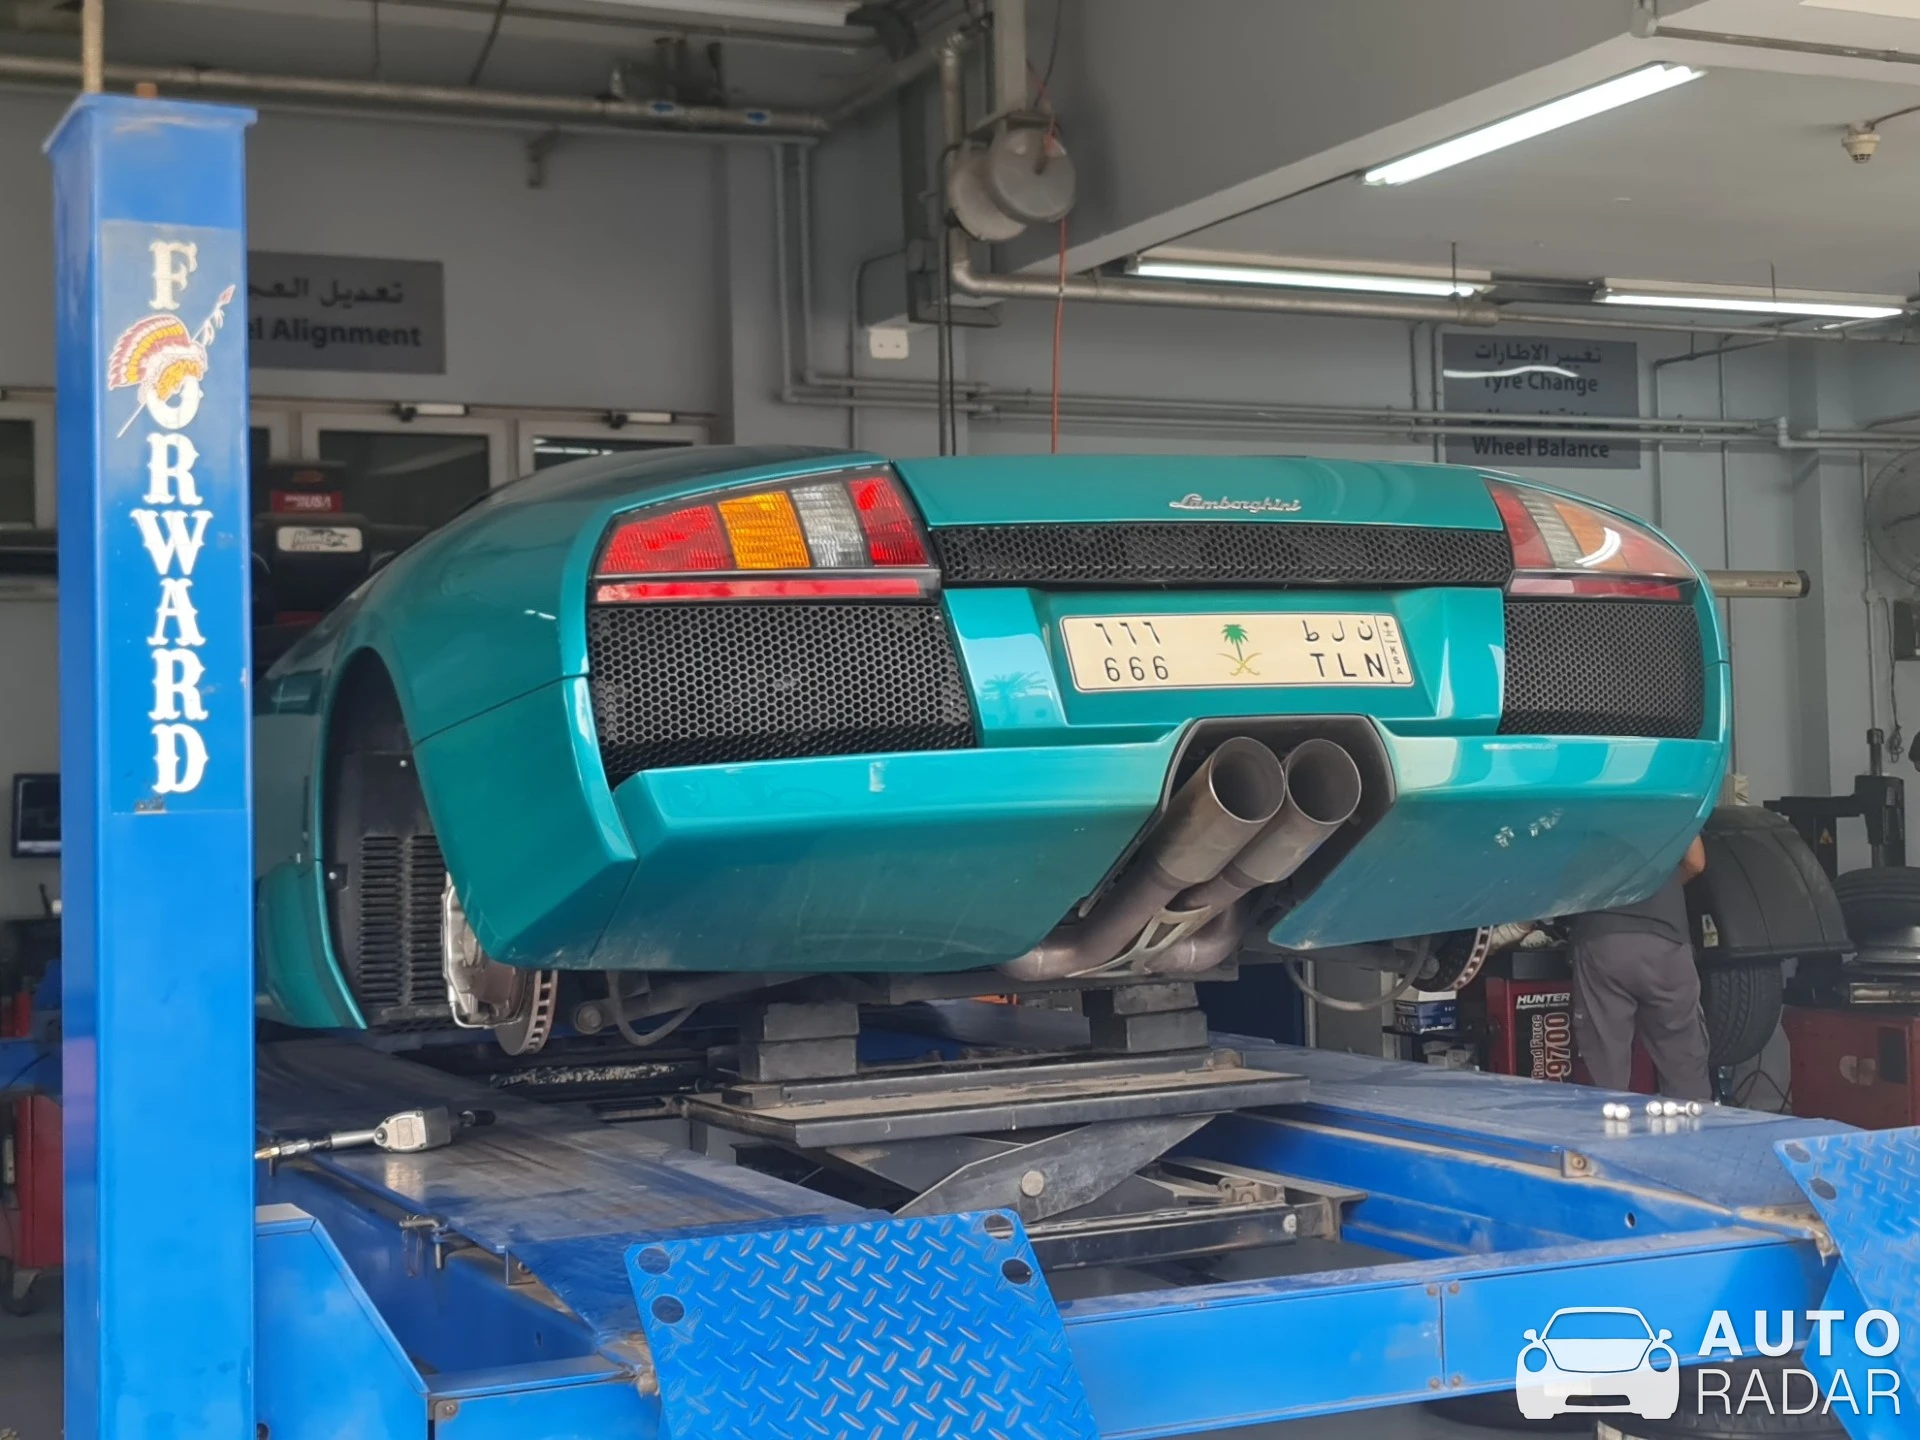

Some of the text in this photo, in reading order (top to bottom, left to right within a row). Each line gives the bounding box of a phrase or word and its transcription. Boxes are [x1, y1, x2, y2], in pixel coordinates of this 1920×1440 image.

[320, 279, 404, 309] تعديل
[272, 318, 422, 349] Alignment
[1555, 345, 1603, 369] تغيير
[1482, 370, 1598, 397] Tyre Change
[1472, 436, 1609, 458] Wheel Balance
[129, 241, 214, 794] FORWARD
[1169, 493, 1302, 513] Lamborghini
[1104, 653, 1385, 682] 666 TLN
[1517, 993, 1570, 1004] HUNTER
[1530, 1014, 1545, 1080] Road Force
[1544, 1012, 1571, 1082] 9700
